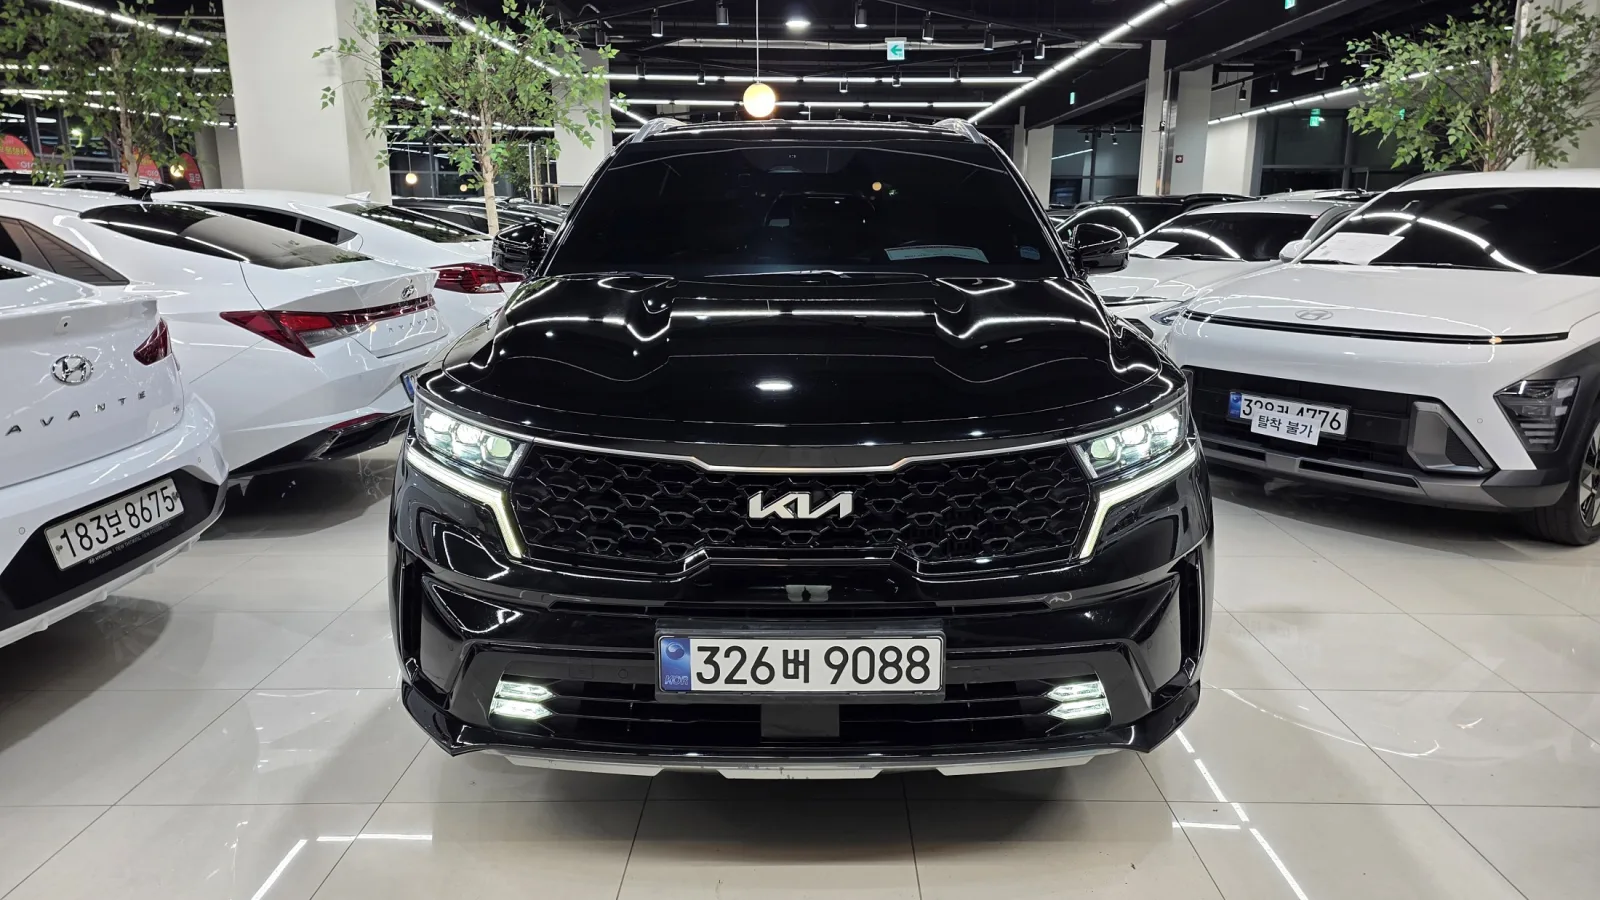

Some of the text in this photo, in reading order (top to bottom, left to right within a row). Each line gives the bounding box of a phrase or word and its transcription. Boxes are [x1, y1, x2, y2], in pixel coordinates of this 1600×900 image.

[5, 390, 147, 436] AVANTE
[1258, 415, 1313, 438] 탈착 불가
[60, 486, 175, 558] 183보 8675
[748, 491, 853, 519] KIA
[664, 674, 689, 686] KOR
[696, 645, 931, 685] 326버 9088
